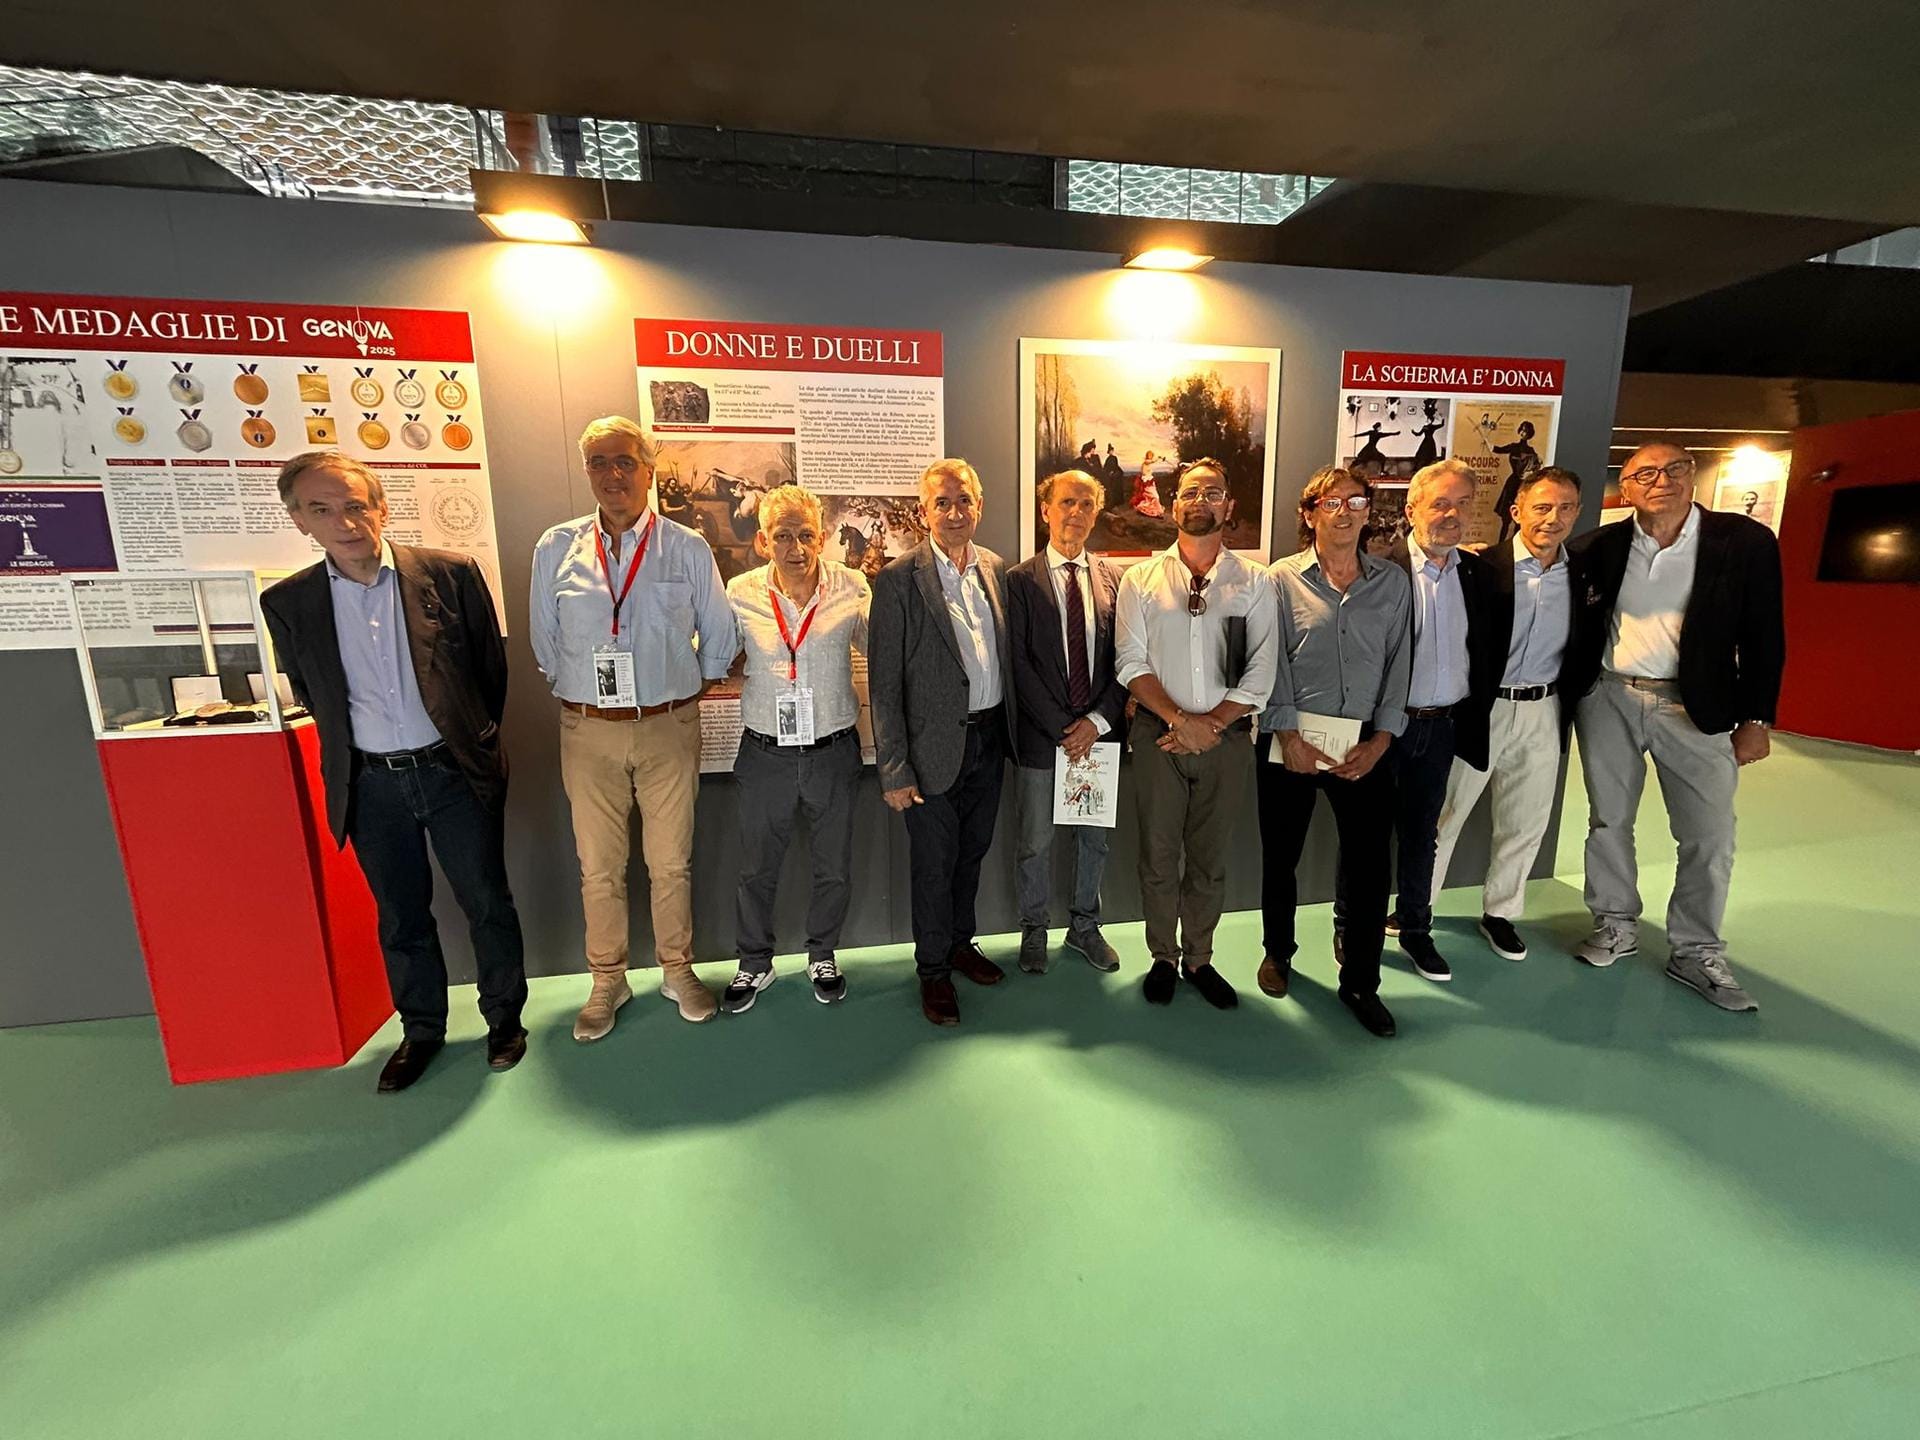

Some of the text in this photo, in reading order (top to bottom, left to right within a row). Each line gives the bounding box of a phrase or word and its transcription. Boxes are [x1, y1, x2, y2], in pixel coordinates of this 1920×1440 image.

[29, 307, 239, 341] MEDAGLIE
[247, 315, 289, 342] DI
[370, 346, 396, 356] 2025
[665, 330, 921, 364] DONNE E DUELLI
[1352, 364, 1376, 382] LA
[1380, 365, 1469, 386] SCHERMA
[1491, 370, 1555, 388] DONNA
